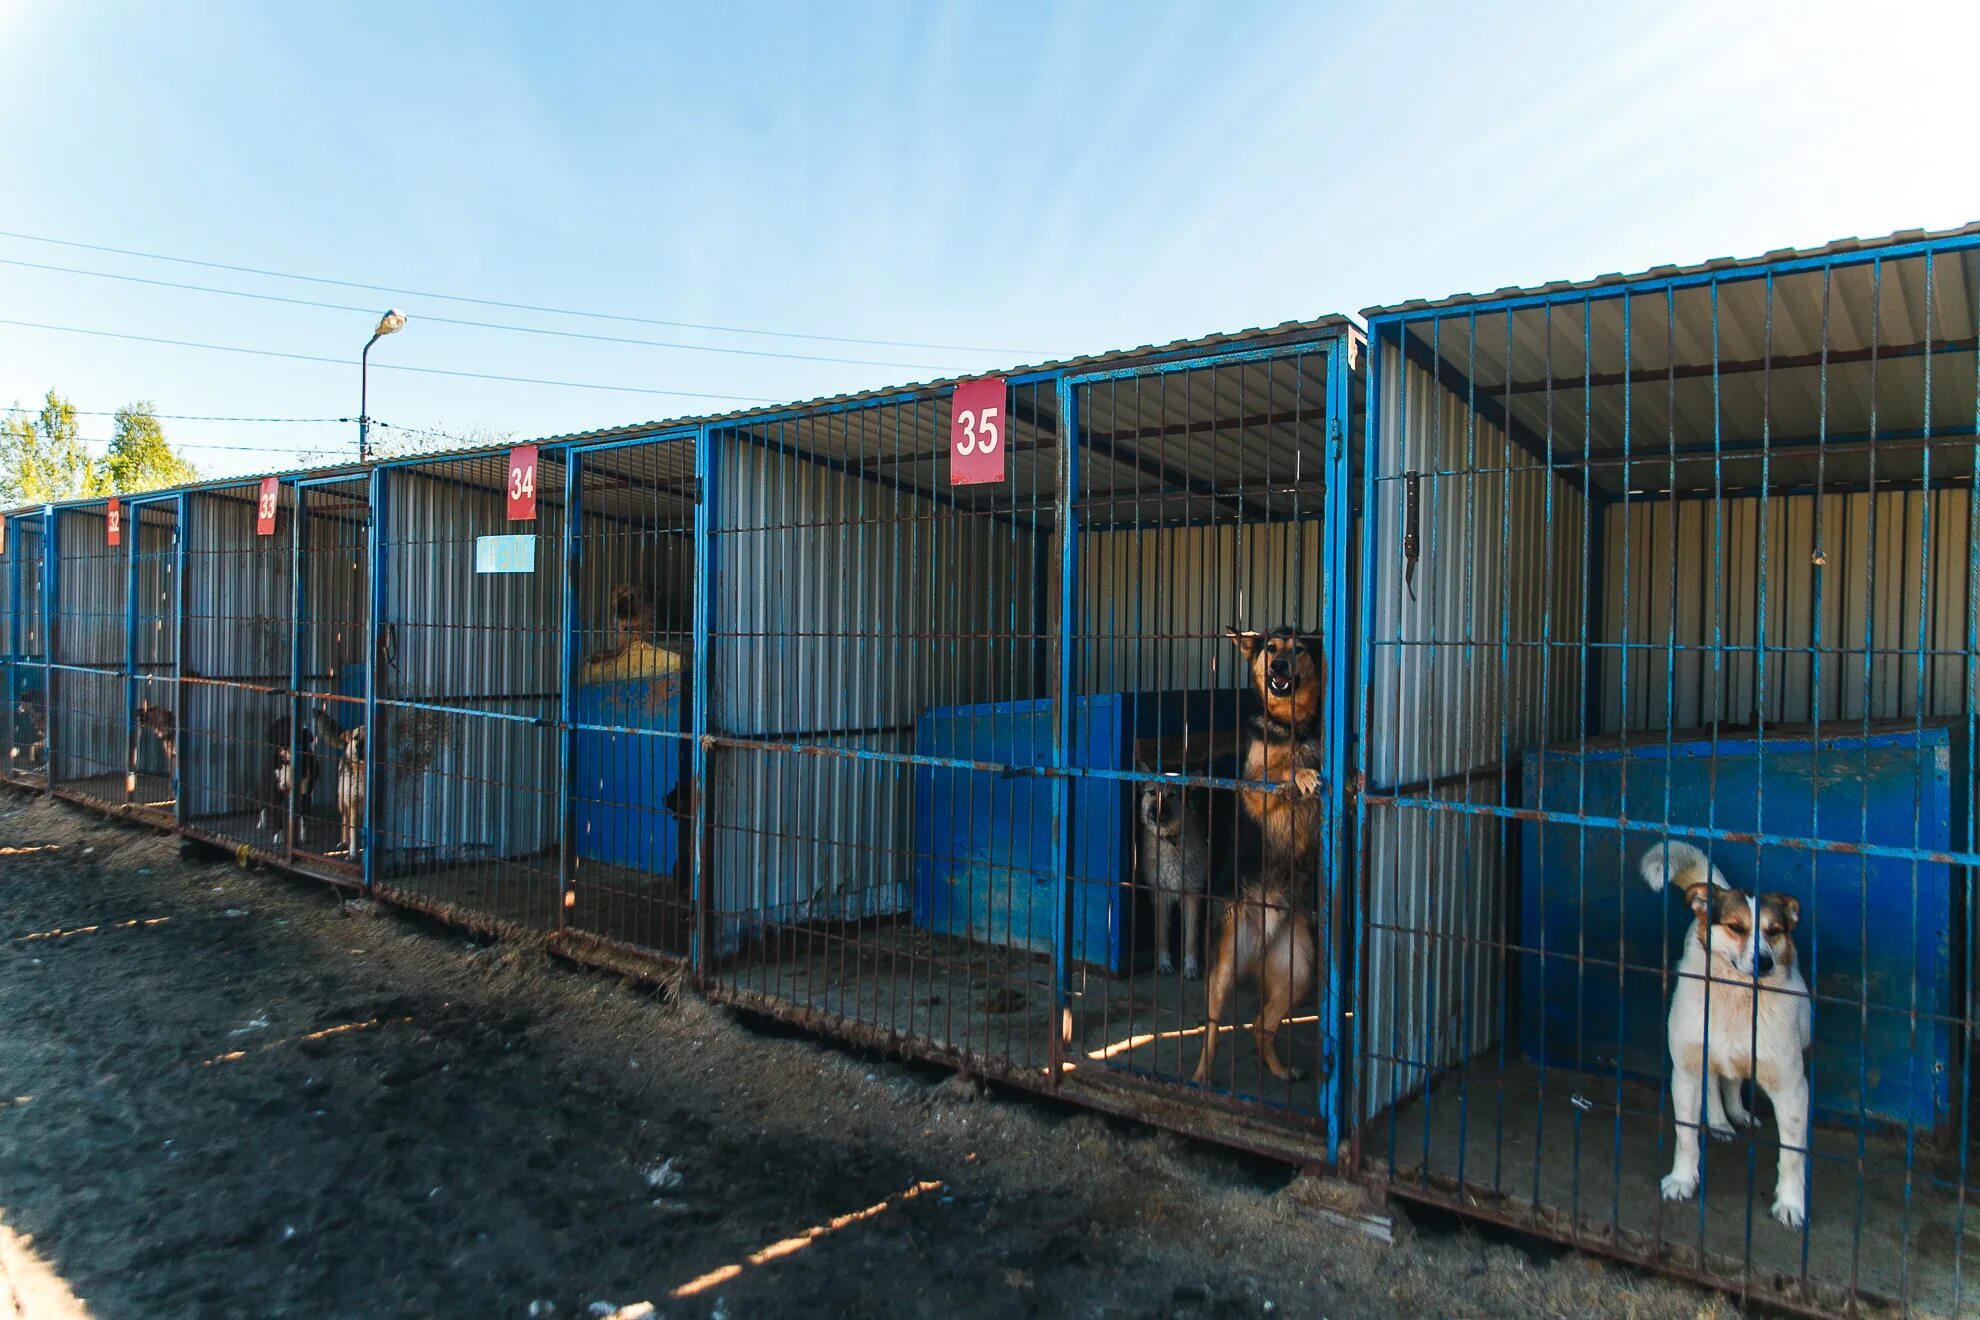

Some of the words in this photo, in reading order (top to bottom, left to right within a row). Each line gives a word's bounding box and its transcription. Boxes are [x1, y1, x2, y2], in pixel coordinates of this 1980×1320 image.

[956, 407, 998, 456] 35
[511, 465, 534, 500] 34
[108, 510, 120, 532] 32
[260, 493, 276, 519] 33
